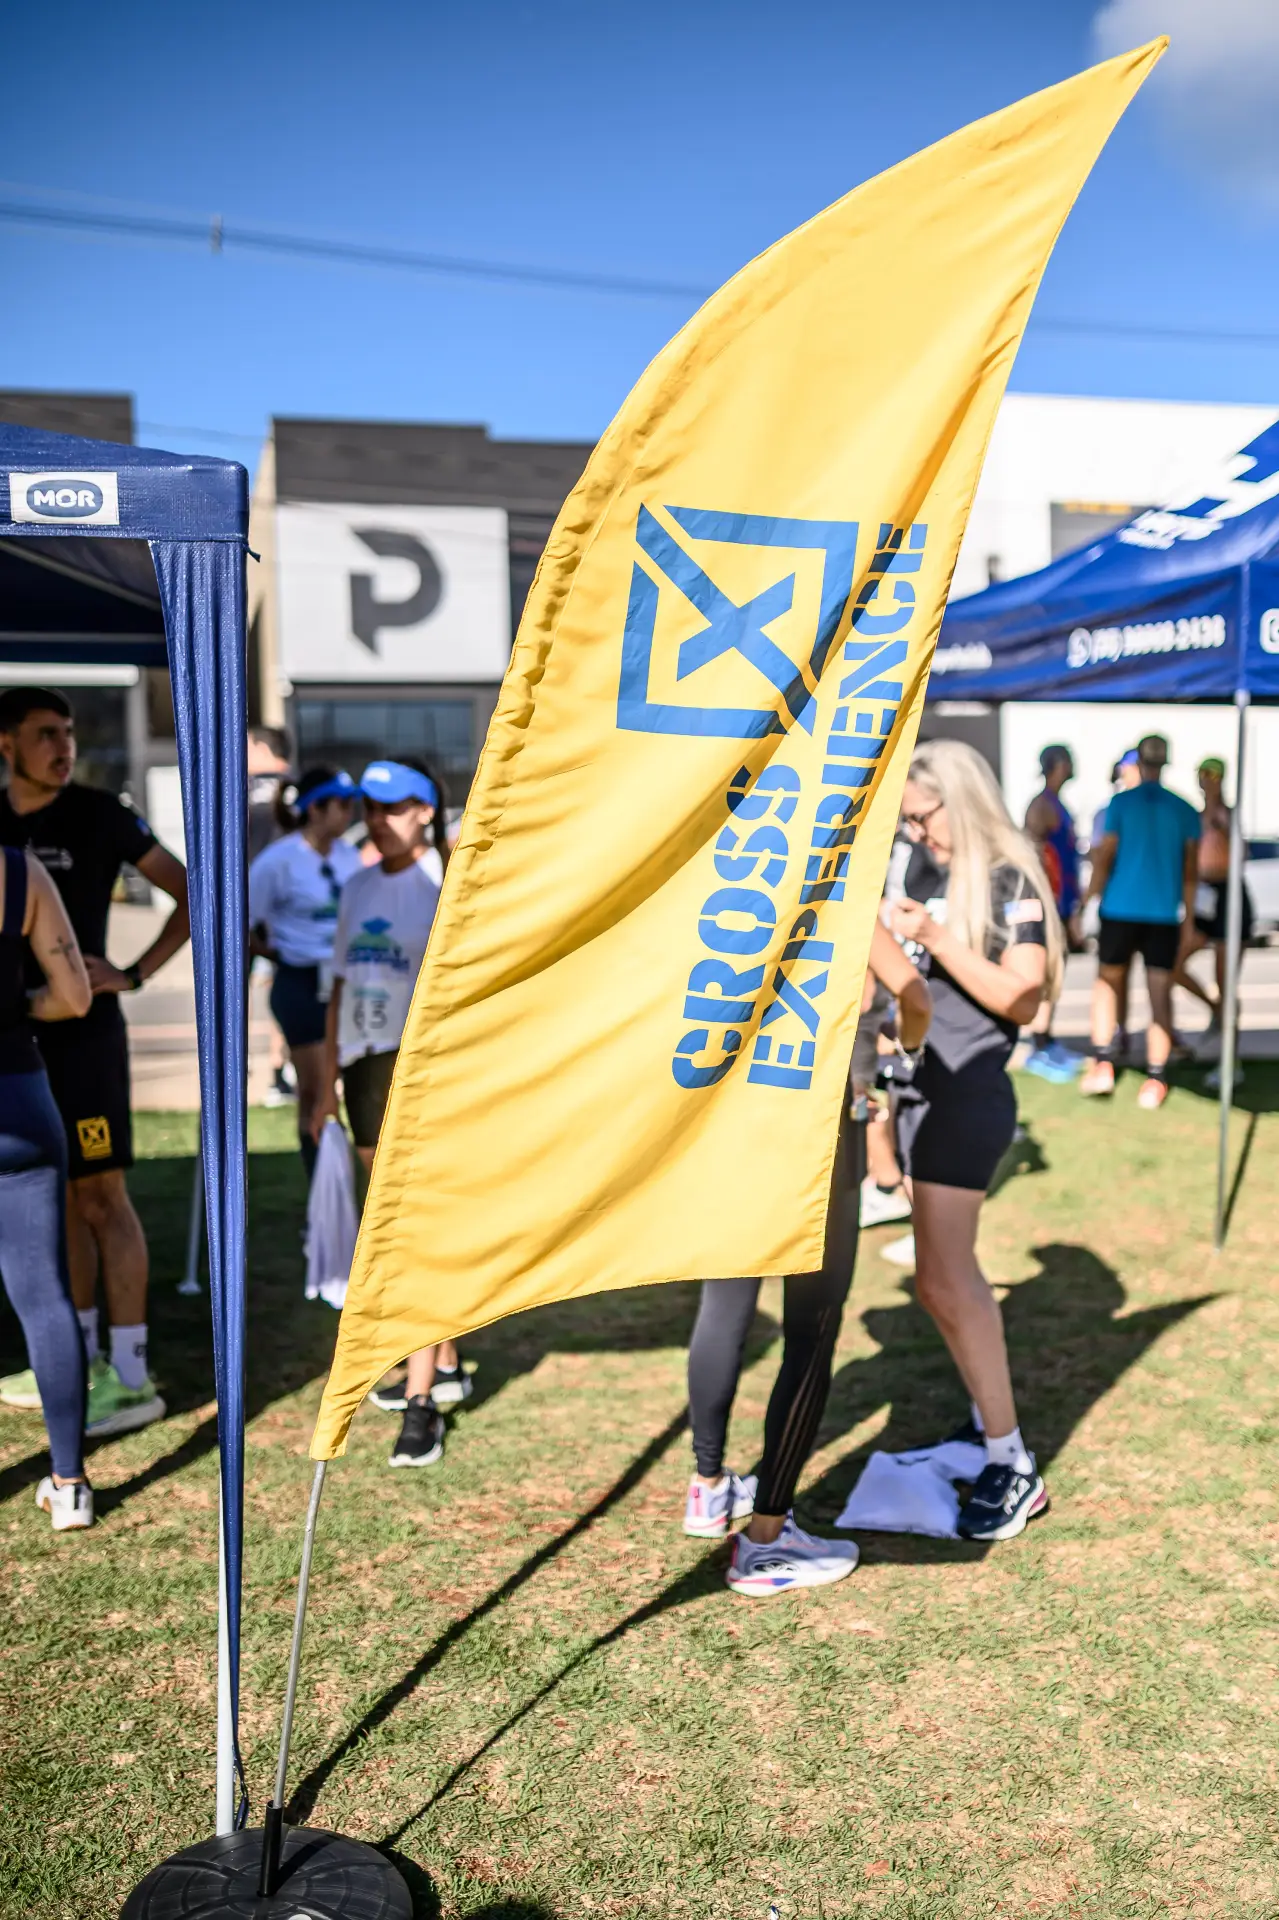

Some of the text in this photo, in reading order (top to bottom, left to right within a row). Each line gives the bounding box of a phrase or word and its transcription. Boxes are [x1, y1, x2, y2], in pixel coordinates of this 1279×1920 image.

[33, 488, 96, 508] MOR
[672, 764, 801, 1090] CROSS
[747, 523, 928, 1090] EXPERIENCE
